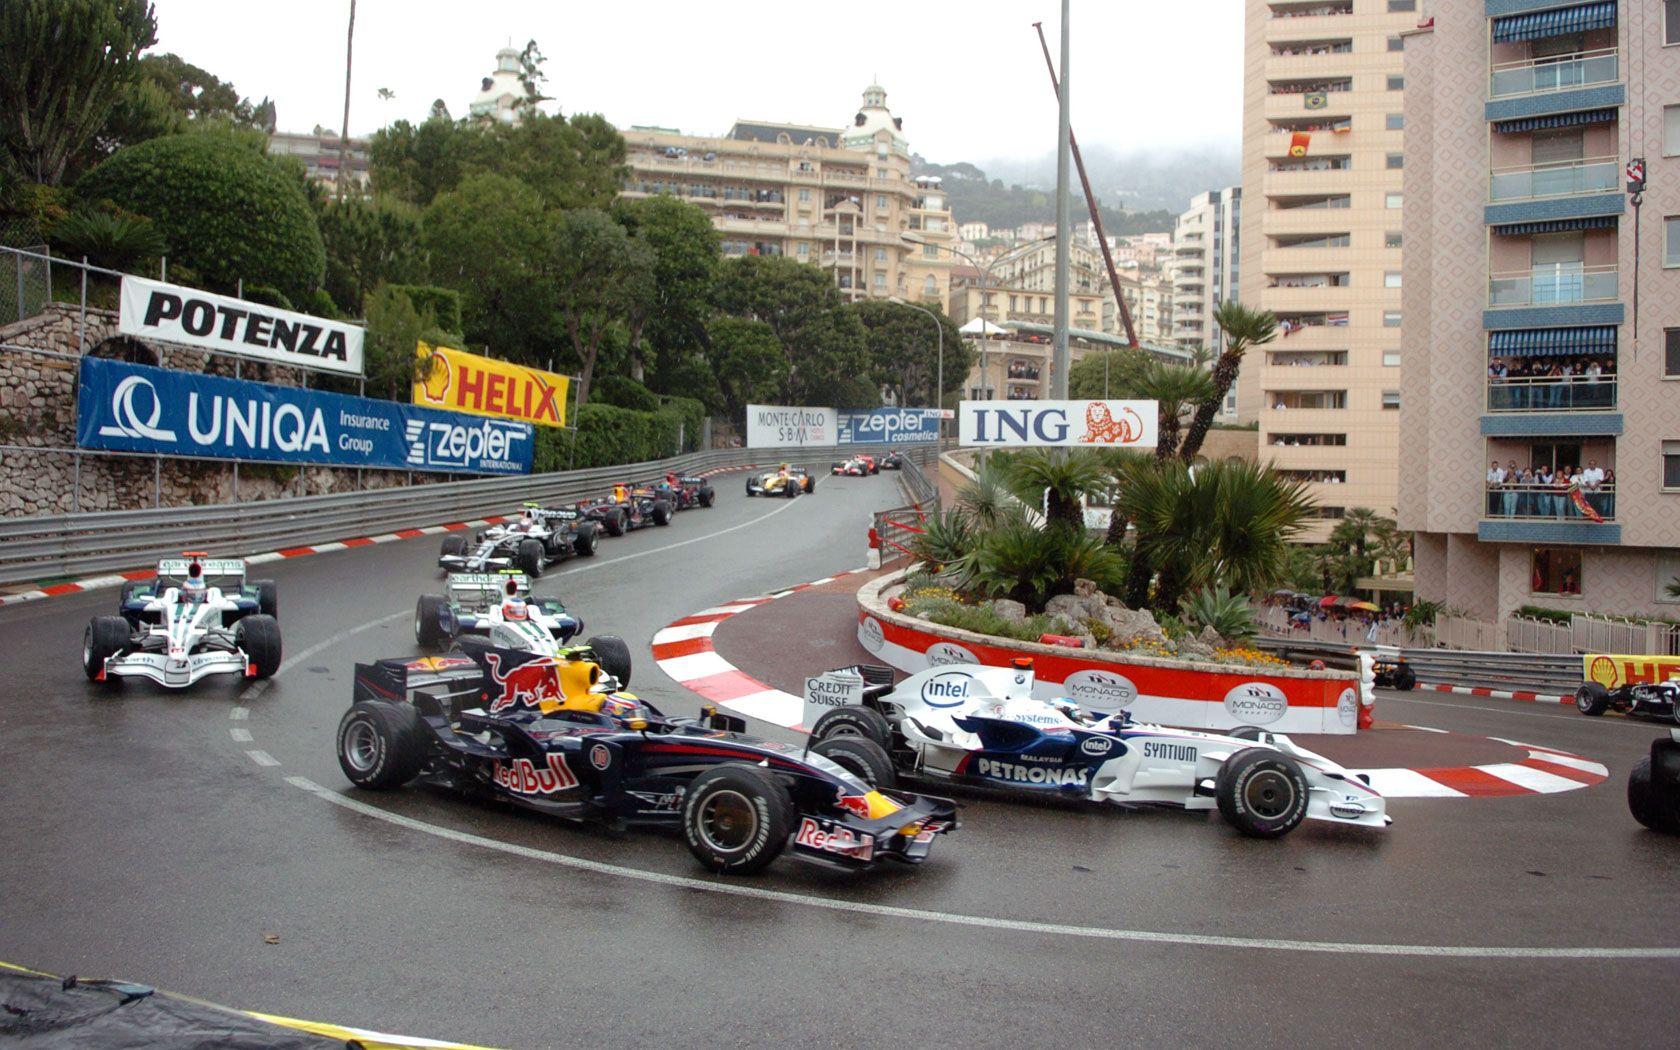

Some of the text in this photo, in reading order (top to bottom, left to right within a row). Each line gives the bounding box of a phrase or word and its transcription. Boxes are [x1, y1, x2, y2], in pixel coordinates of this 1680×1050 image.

[143, 290, 348, 363] POTENZA
[457, 366, 560, 424] HELIX
[187, 391, 330, 454] UNIQA
[340, 409, 390, 432] Insurance
[856, 410, 926, 442] zepter
[972, 409, 1071, 442] ING
[339, 434, 374, 454] Group
[428, 420, 527, 466] zepter
[891, 429, 939, 443] cosmetics
[807, 678, 851, 695] CREDIT
[928, 679, 969, 698] intel
[1072, 684, 1130, 698] MONACO
[809, 691, 849, 707] SUISSE
[1232, 701, 1283, 710] MONACO
[1085, 739, 1107, 751] intel
[1144, 742, 1198, 763] SYNTIUM
[1020, 754, 1063, 763] MALAYSIA
[493, 752, 579, 794] Red Bull
[978, 758, 1089, 786] PETRONAS
